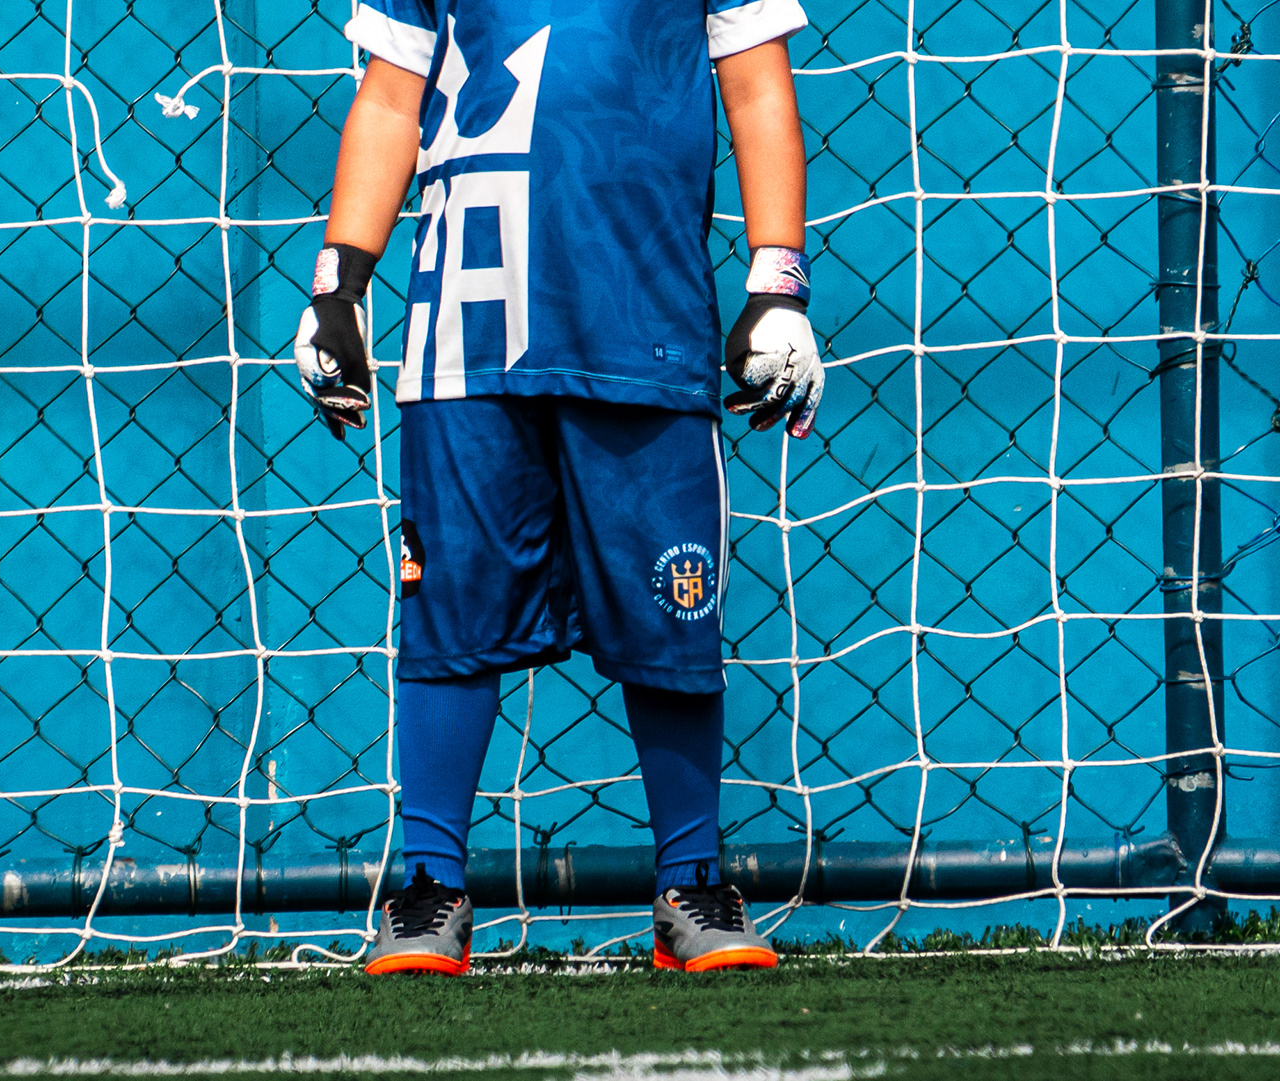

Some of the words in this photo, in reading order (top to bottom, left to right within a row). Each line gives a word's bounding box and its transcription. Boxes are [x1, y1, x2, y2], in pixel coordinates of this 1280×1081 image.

[654, 347, 663, 358] 14
[654, 545, 680, 572] CENTRO
[653, 593, 673, 613] CAIO
[673, 578, 703, 608] CA
